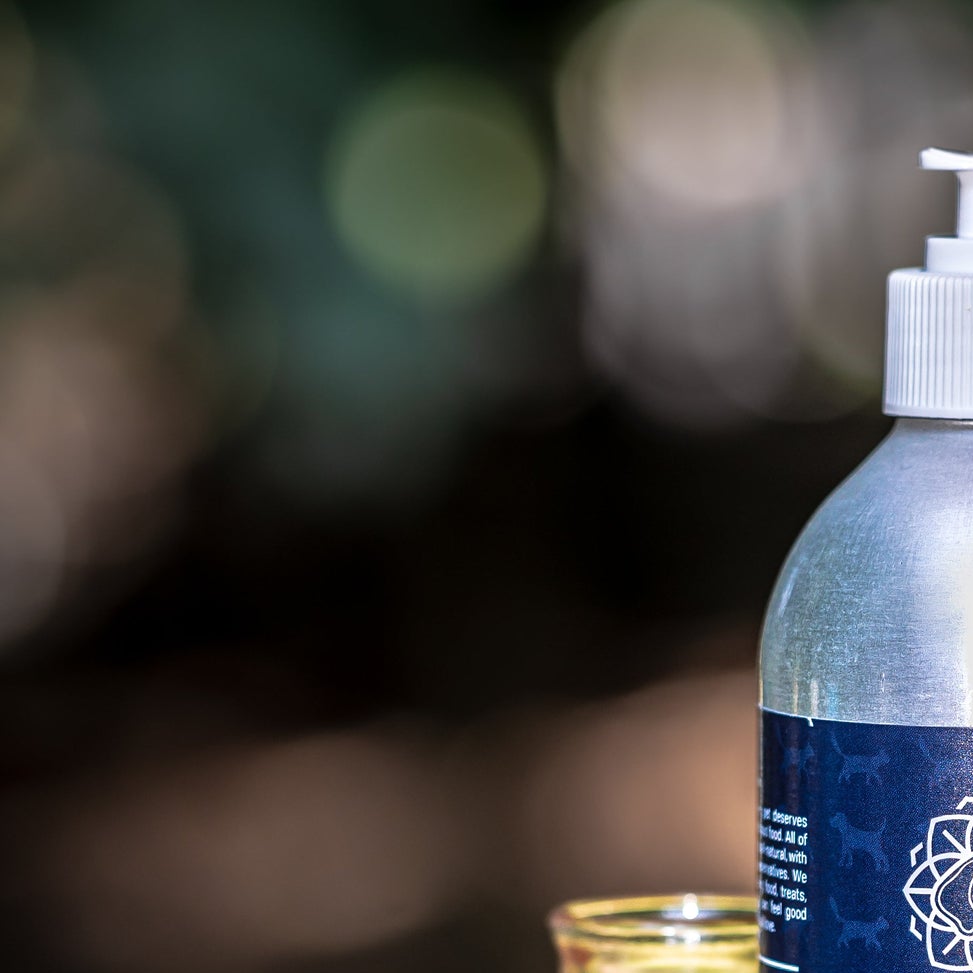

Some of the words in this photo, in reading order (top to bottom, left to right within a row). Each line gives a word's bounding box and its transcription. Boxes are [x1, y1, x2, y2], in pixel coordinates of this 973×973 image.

[772, 808, 808, 828] deserves
[785, 829, 796, 845] All
[798, 832, 808, 847] of
[788, 850, 808, 865] with
[792, 868, 808, 884] We
[780, 885, 808, 904] treats,
[785, 906, 807, 922] good
